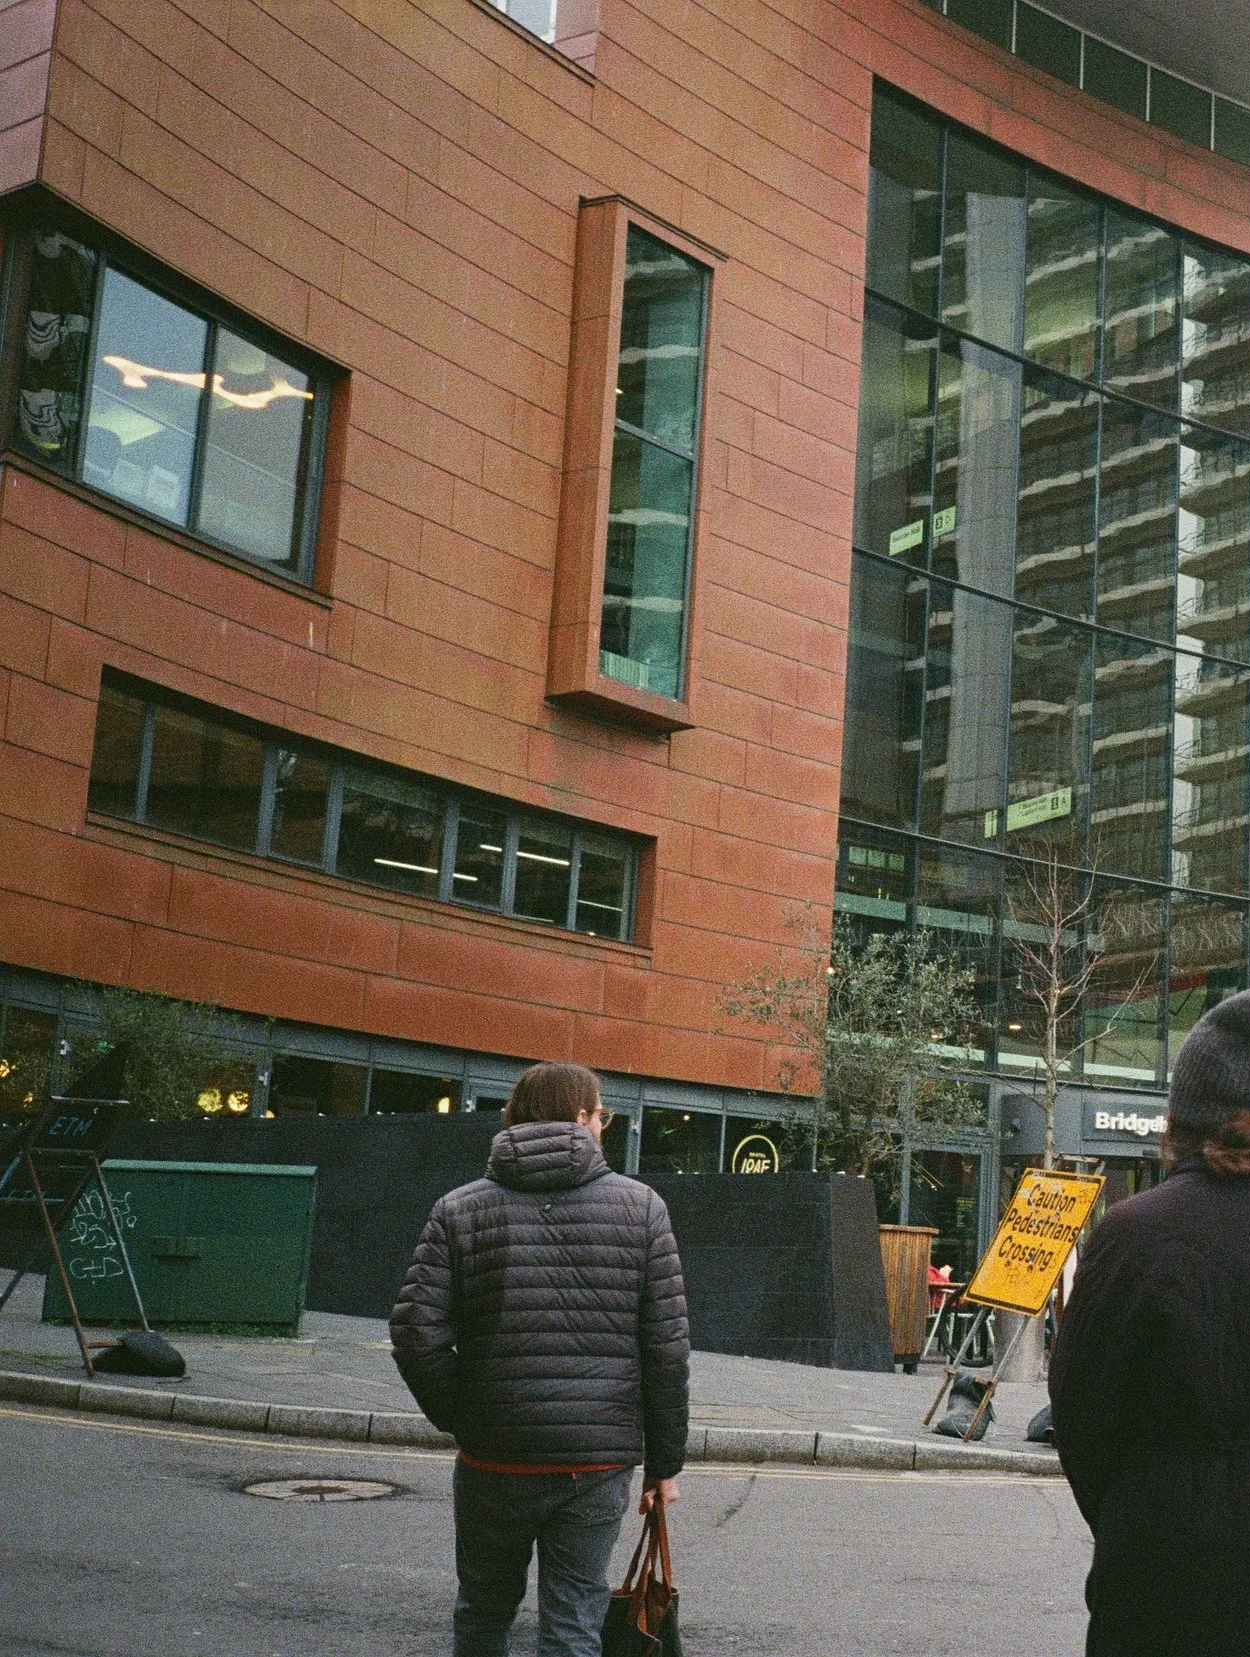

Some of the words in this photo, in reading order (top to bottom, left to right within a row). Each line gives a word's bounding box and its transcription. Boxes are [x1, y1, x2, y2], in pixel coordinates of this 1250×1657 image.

[1027, 1183, 1076, 1213] Caution
[1003, 1207, 1081, 1243] Pedestrians
[998, 1235, 1054, 1272] Crossing
